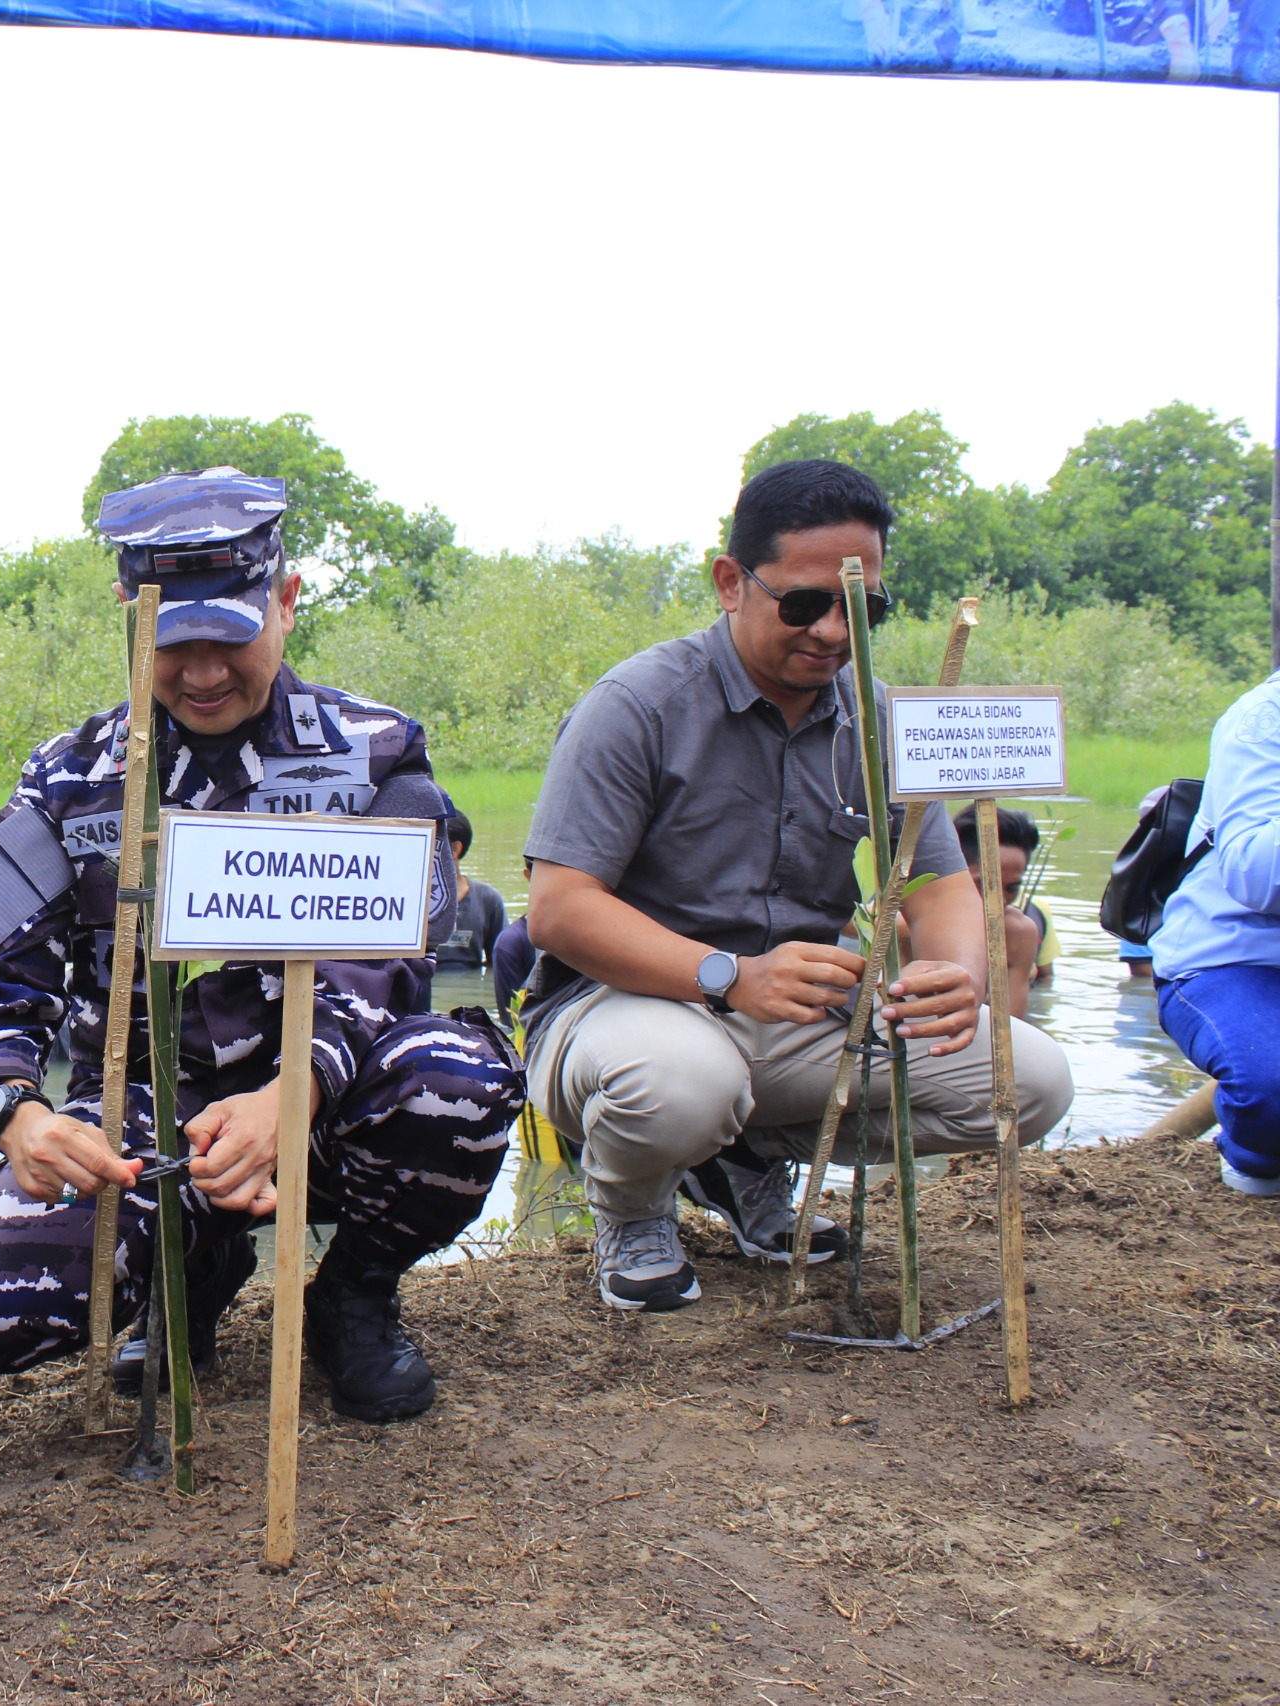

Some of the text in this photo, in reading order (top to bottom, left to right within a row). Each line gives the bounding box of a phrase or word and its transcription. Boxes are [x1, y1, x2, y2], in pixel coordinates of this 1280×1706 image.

[938, 705, 1022, 719] KEPALA BIDANG
[905, 726, 1056, 742] PENGAWASAN SUMBERDAYA
[907, 745, 1052, 761] KELAUTAN DAN PERIKANAN
[939, 767, 1025, 782] PROVINSI JABAR
[263, 791, 360, 816] TNI AL
[75, 820, 122, 849] FAIS
[224, 850, 381, 880] KOMANDAN
[187, 892, 405, 922] LANAL CIREBON
